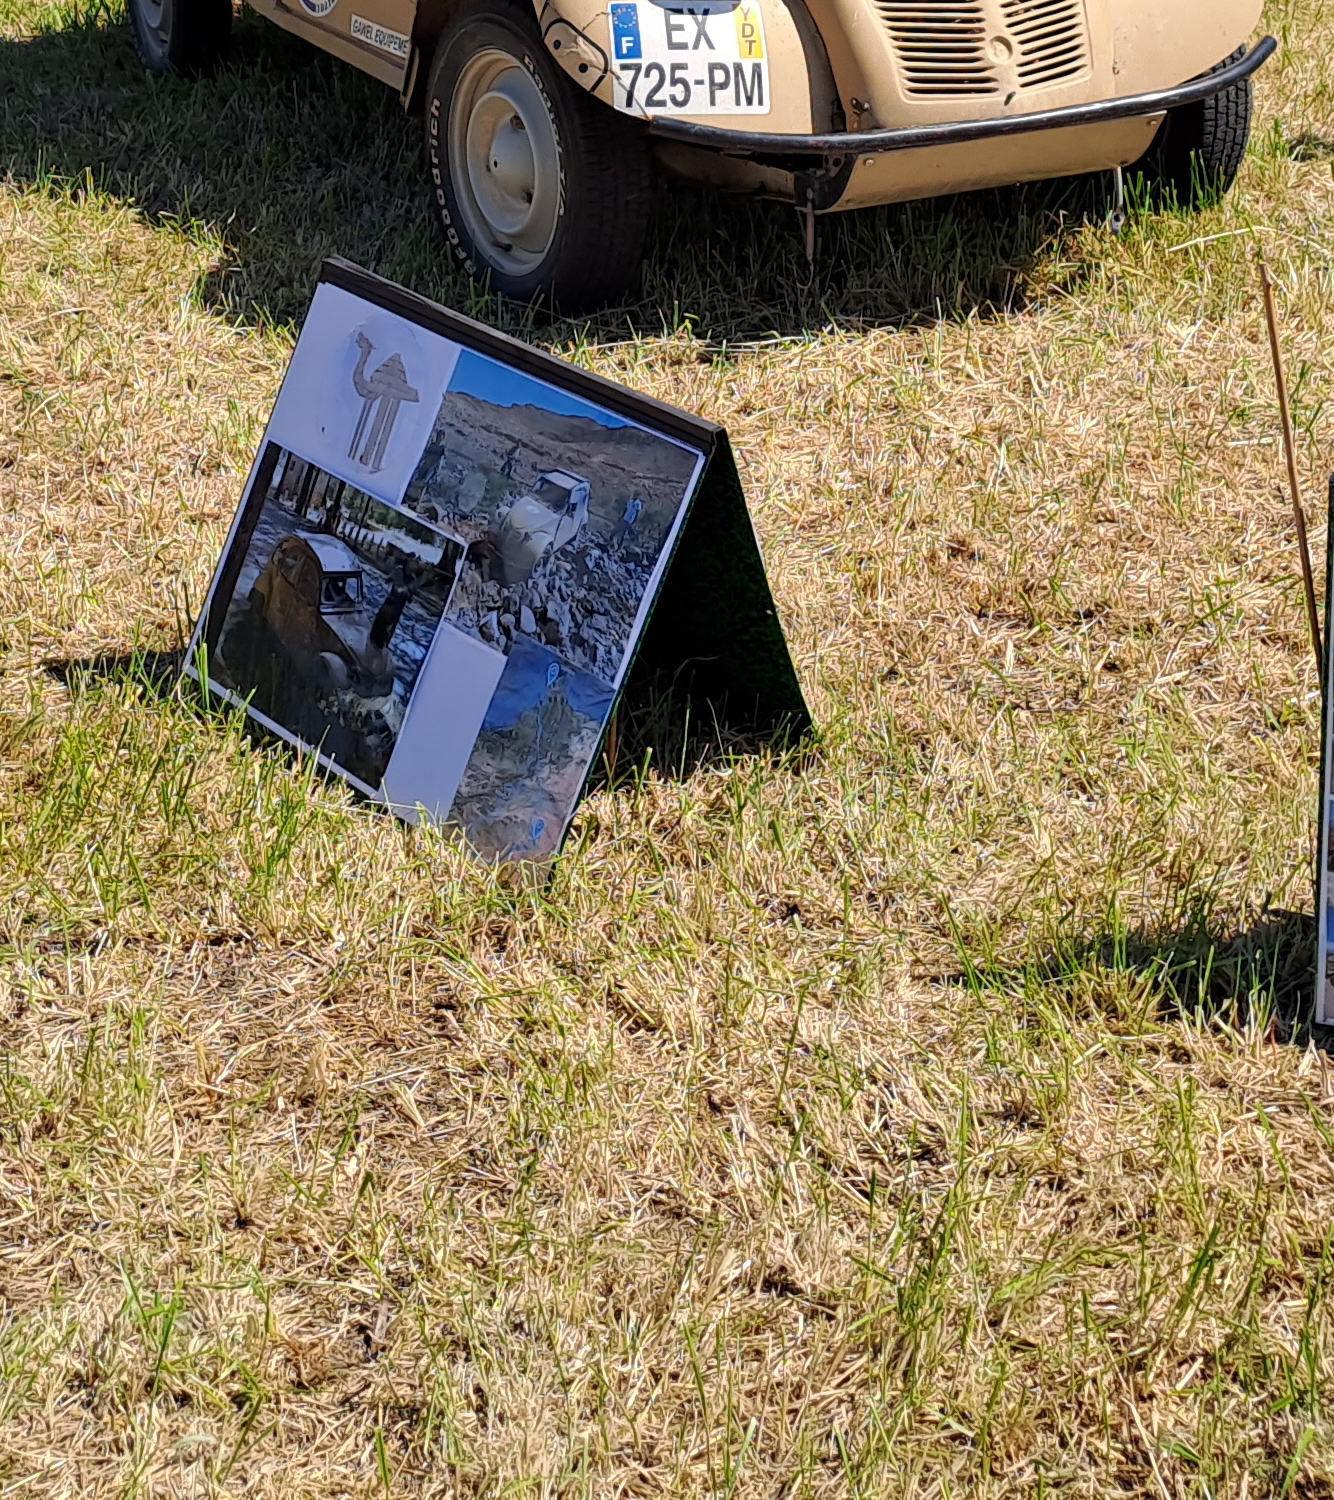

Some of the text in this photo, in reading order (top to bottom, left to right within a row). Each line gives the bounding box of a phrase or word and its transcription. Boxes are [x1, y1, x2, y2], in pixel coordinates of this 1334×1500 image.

[621, 36, 635, 55] F
[664, 7, 716, 51] EX
[619, 61, 765, 109] 725-PM
[428, 97, 477, 276] BFGoodrich
